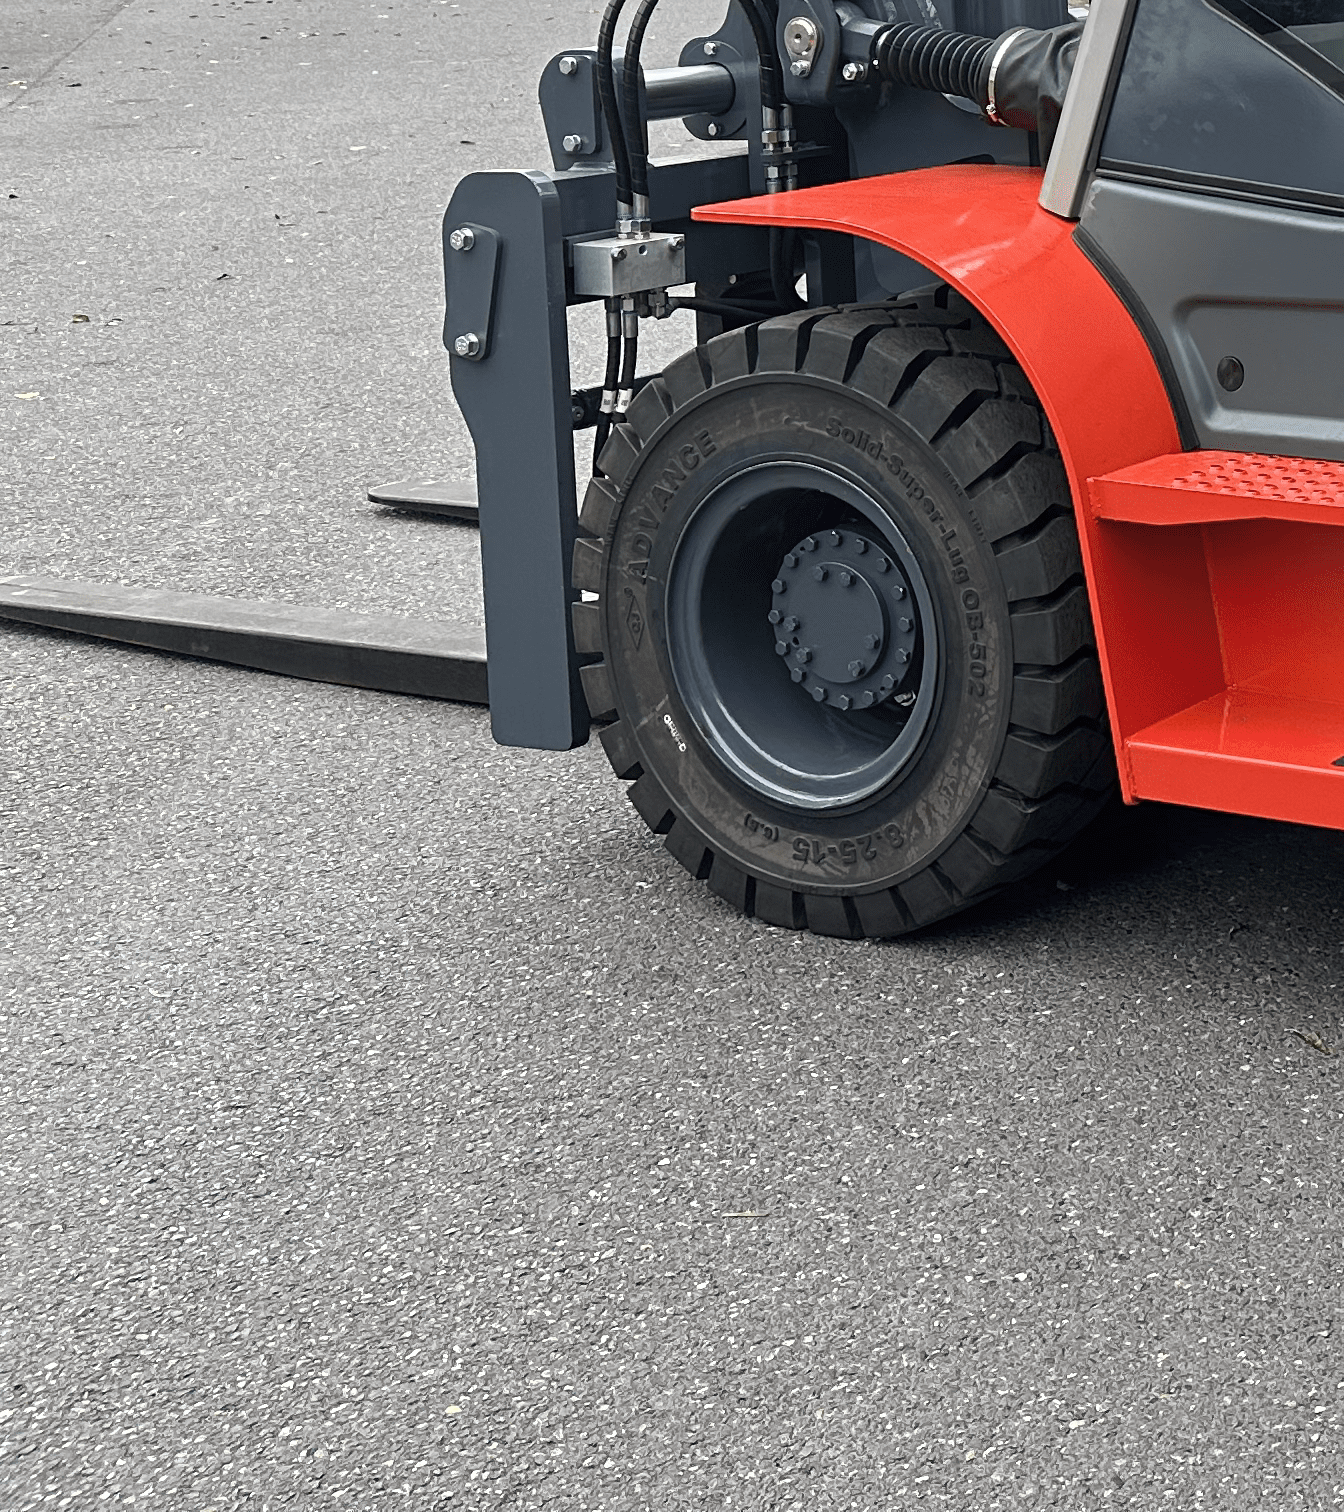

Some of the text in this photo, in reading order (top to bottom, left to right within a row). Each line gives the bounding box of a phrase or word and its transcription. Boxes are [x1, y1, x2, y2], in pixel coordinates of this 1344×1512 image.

[627, 428, 717, 585] ADVANCE
[825, 416, 987, 698] Solid-Super-Lug OB-502
